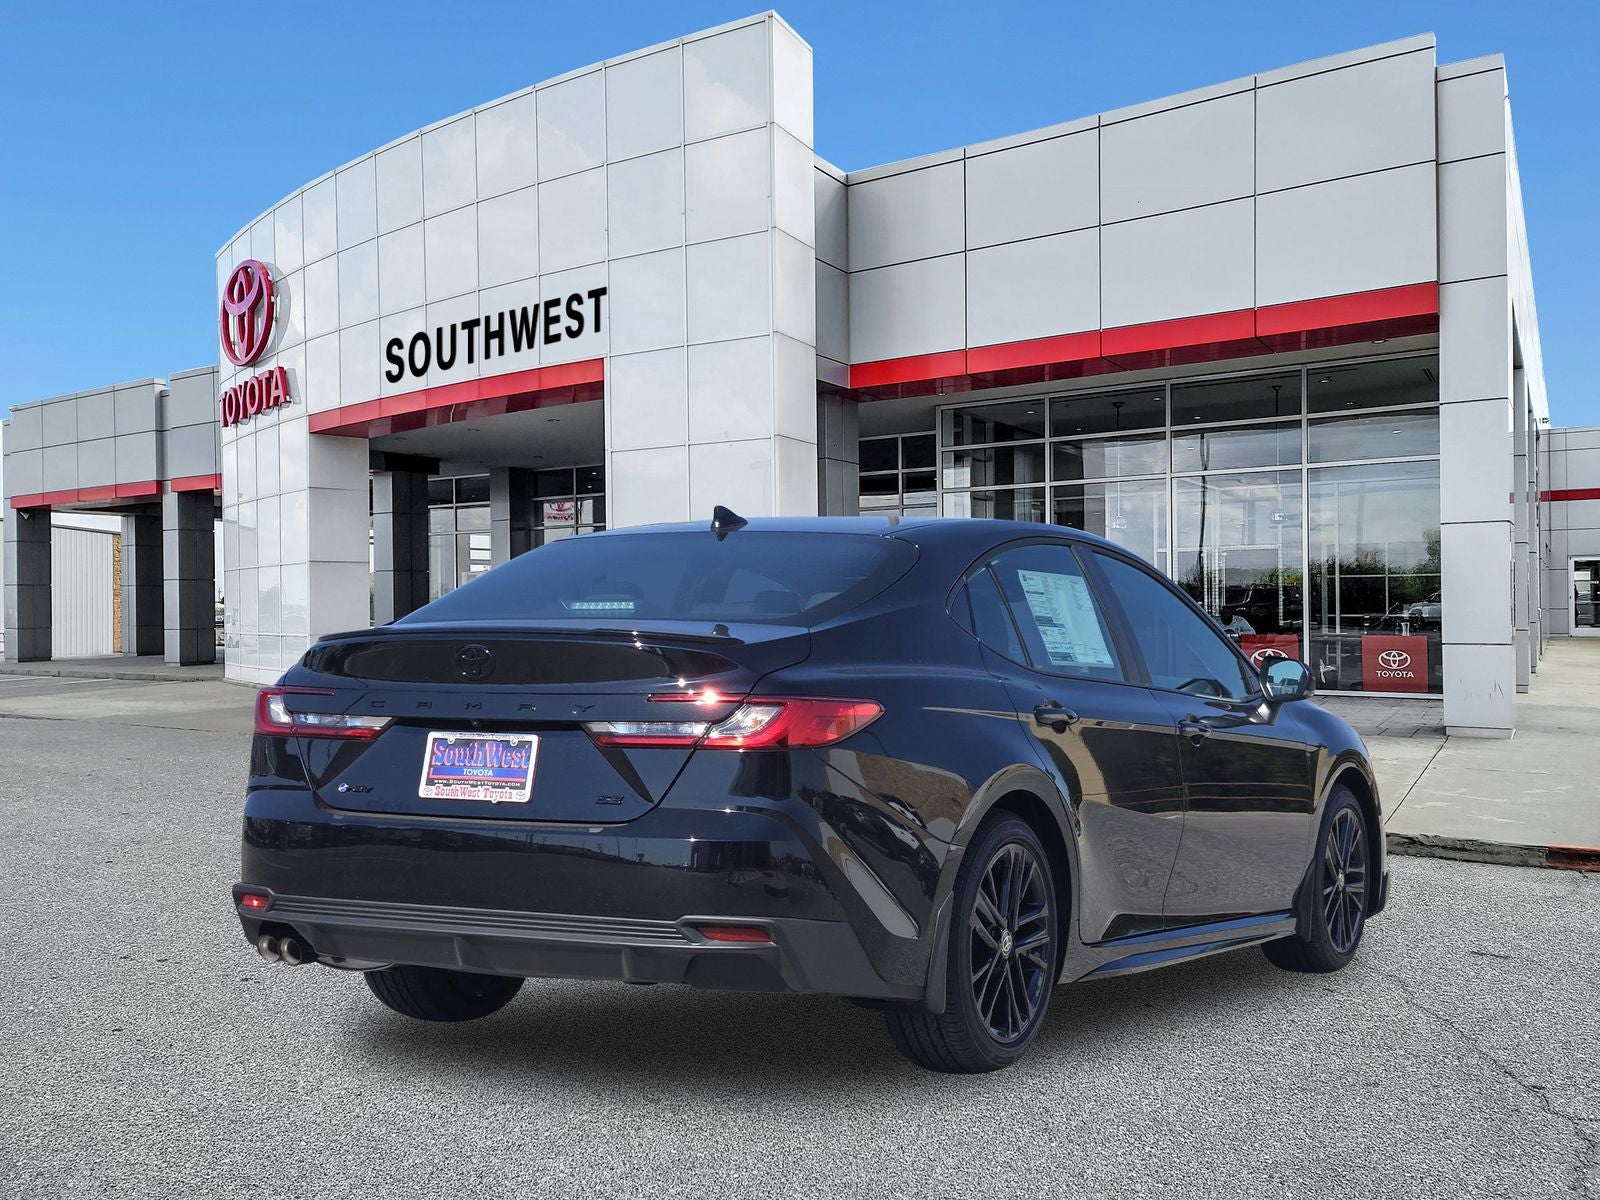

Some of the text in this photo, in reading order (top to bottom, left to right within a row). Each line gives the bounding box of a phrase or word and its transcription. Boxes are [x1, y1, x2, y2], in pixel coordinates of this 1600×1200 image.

[385, 286, 608, 383] SOUTHWEST
[218, 366, 291, 427] TOYOTA
[1375, 670, 1414, 678] TOYOTA
[370, 700, 596, 713] CAMRY
[463, 768, 494, 776] TOYOTA
[484, 787, 513, 801] Toyota
